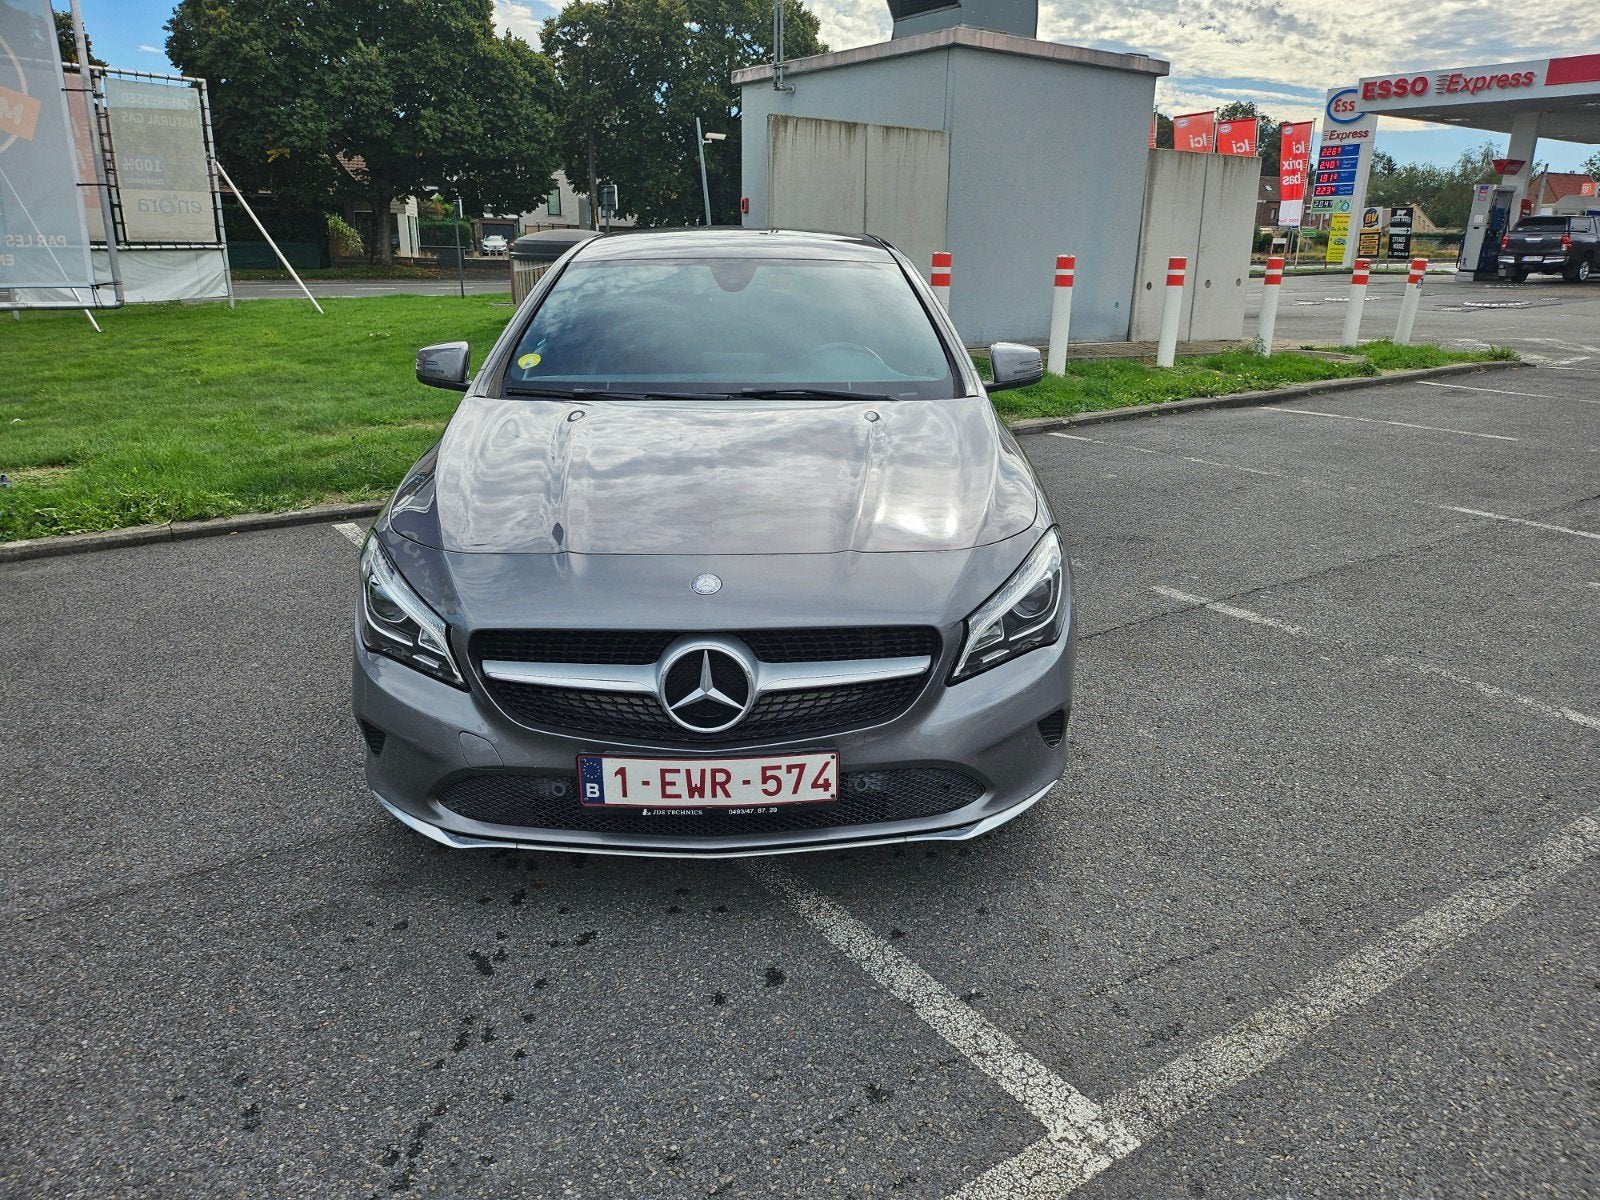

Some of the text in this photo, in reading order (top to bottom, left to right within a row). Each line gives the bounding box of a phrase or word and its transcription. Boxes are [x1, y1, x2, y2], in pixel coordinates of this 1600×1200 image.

[1362, 71, 1535, 100] ESSO Express
[1333, 99, 1356, 113] Ess
[1329, 129, 1370, 142] Express
[586, 761, 832, 799] B 1-EWR-574
